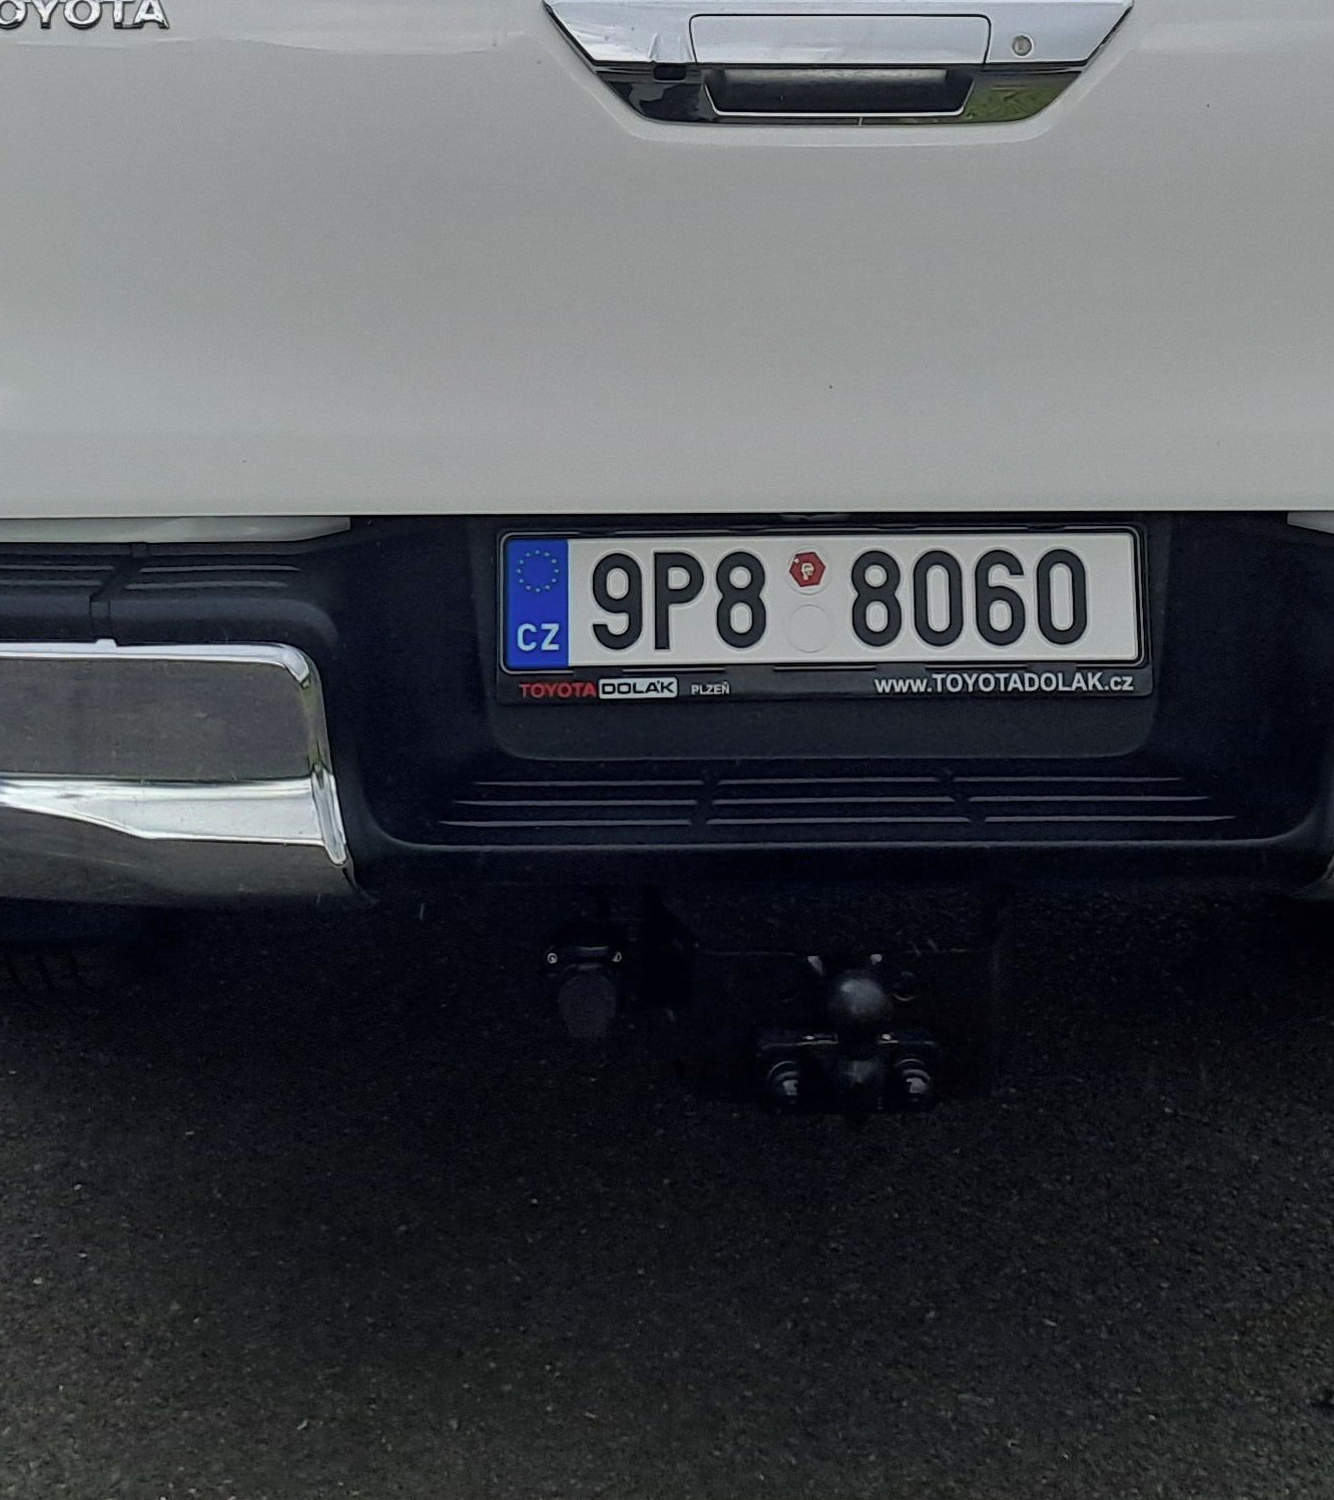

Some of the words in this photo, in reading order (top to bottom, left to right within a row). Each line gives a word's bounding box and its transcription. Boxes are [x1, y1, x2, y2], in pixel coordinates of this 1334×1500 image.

[592, 551, 767, 650] 9P8
[851, 548, 1088, 648] 8060
[517, 622, 560, 651] CZ
[519, 682, 597, 698] TOYOTA
[690, 680, 730, 696] PLZEŇ
[874, 671, 1135, 694] www.TOYOTADOLAK.cz
